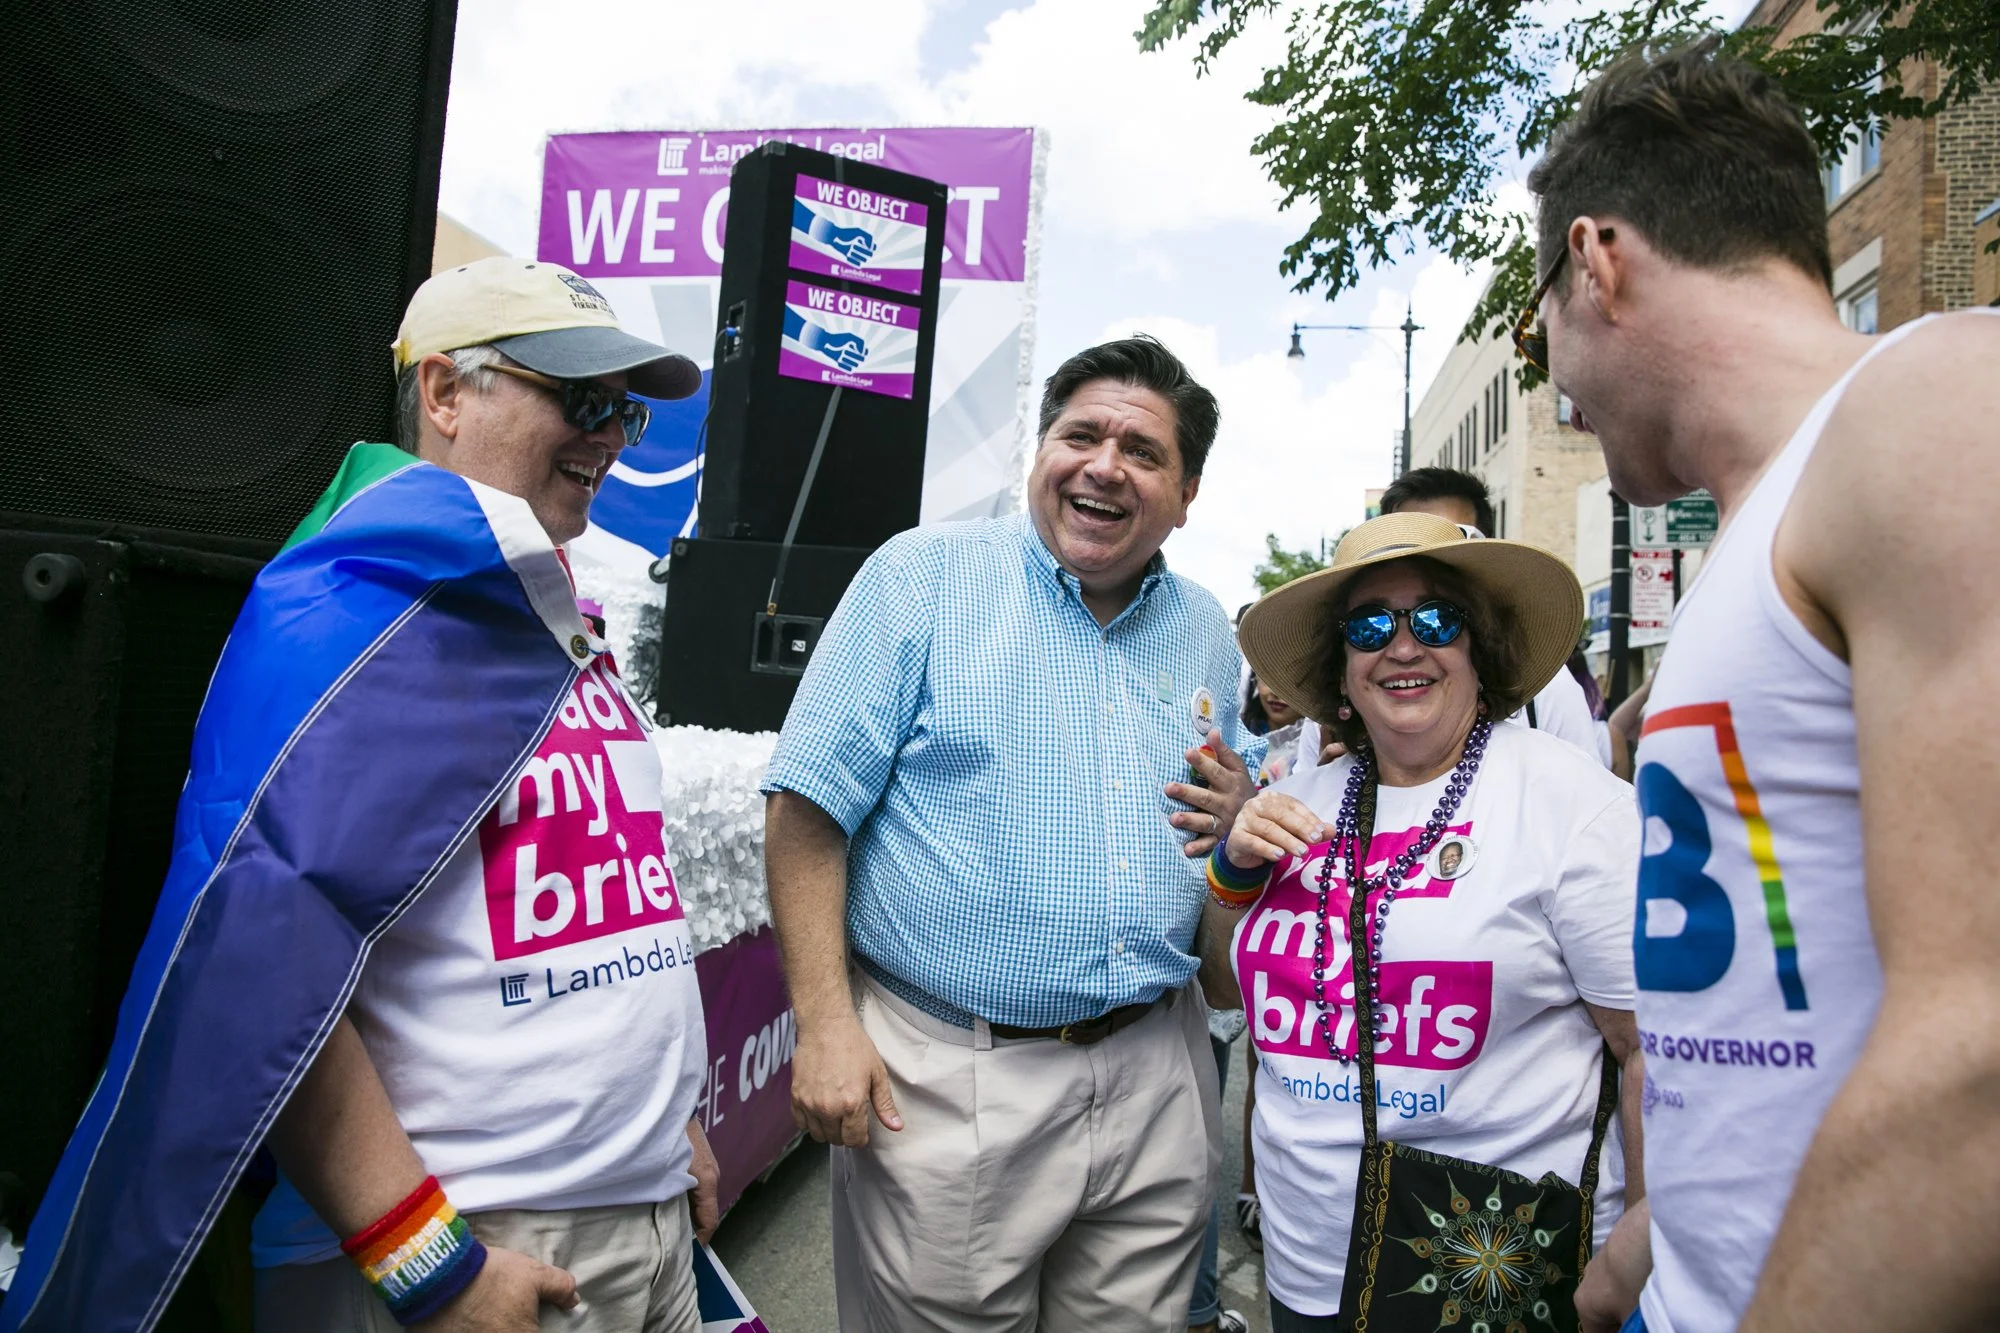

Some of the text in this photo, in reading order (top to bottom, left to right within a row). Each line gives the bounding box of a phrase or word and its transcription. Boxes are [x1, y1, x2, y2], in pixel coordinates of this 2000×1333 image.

[700, 135, 806, 165] Lam
[567, 188, 680, 265] WE
[817, 181, 909, 221] WE OBJECT
[572, 301, 599, 310] VIRGIN
[807, 287, 901, 324] WE OBJECT
[558, 664, 628, 731] ad
[499, 752, 609, 836] my
[546, 938, 677, 999] Lambda
[1246, 907, 1372, 981] my
[1253, 970, 1478, 1060] briefs
[1639, 1030, 1817, 1069] OR GOVERNOR
[698, 1054, 727, 1134] HE
[1281, 1071, 1445, 1120] ambda Legal
[381, 1223, 460, 1299] WE OBJECT!
